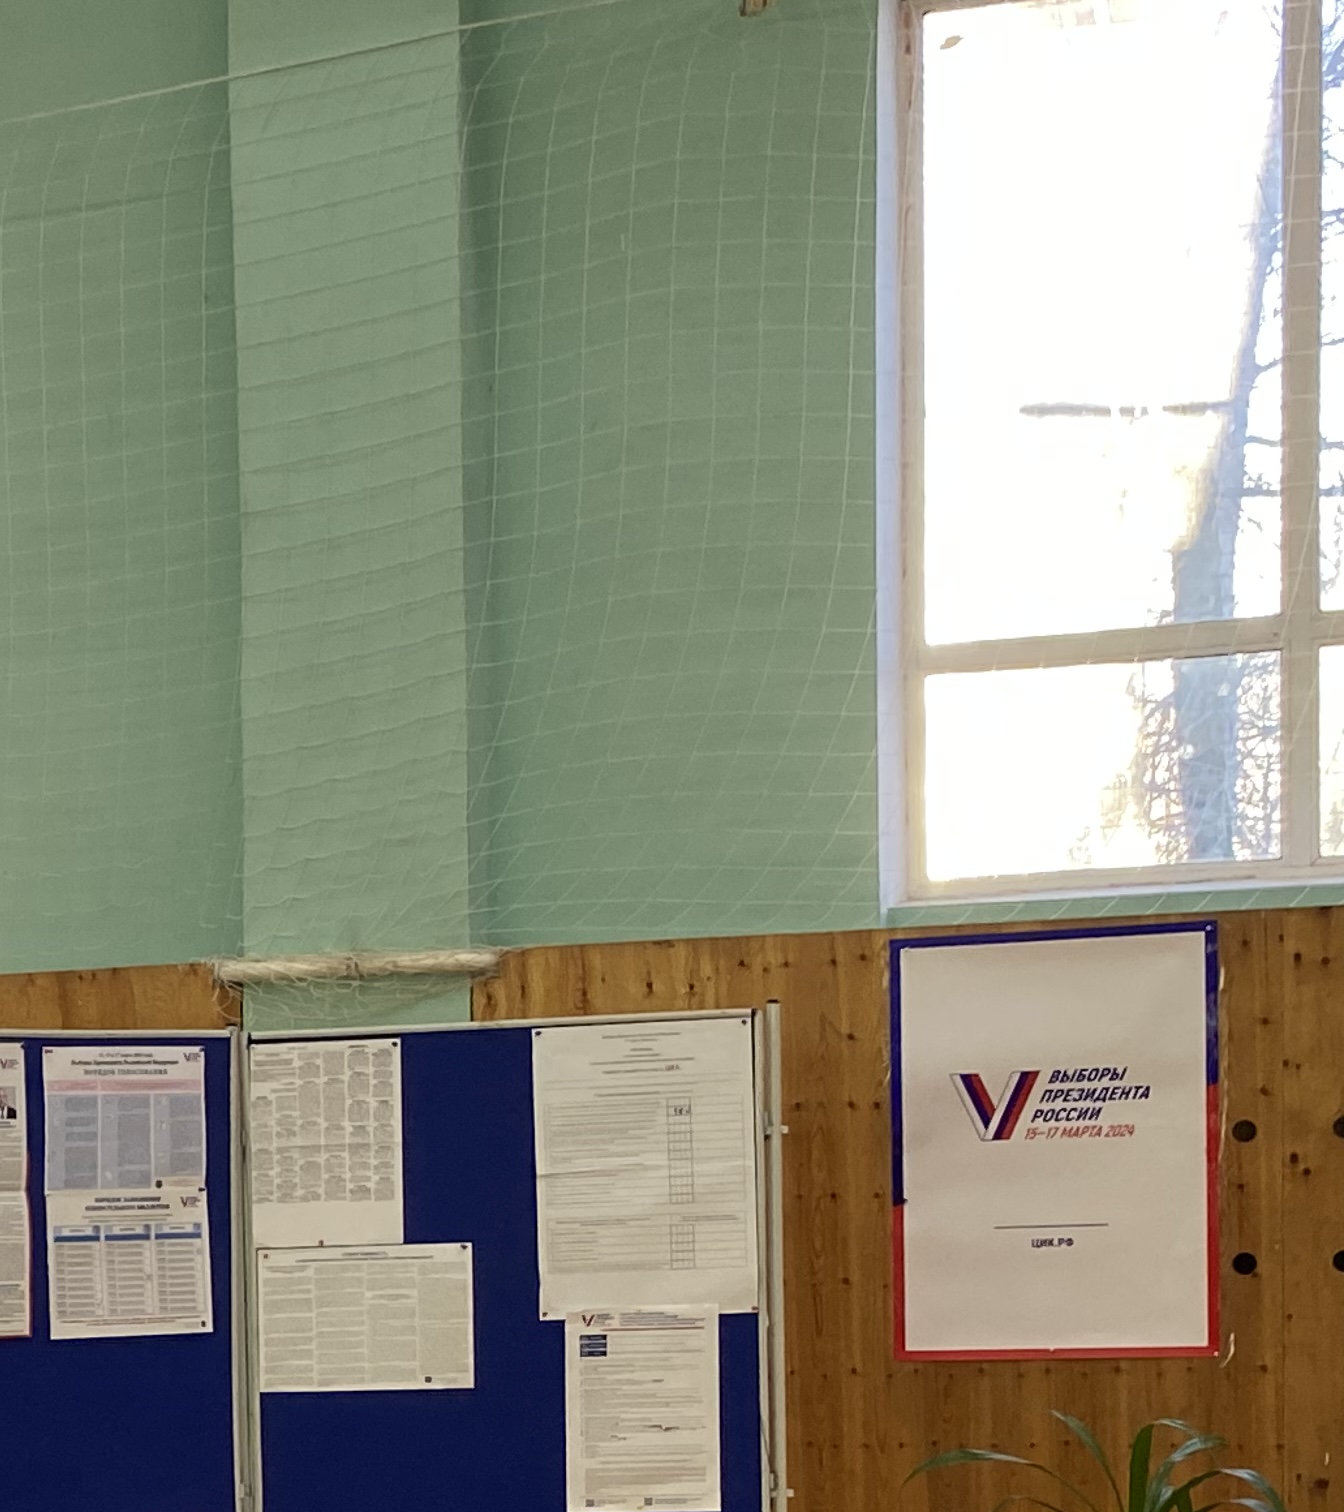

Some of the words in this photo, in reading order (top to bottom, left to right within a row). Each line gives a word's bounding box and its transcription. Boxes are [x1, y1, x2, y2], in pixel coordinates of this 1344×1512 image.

[1047, 1066, 1128, 1084] ВЫБОРЫ
[1039, 1085, 1151, 1104] ПРЕЗИДЕНТА
[1031, 1106, 1103, 1123] РОССИИ
[1060, 1125, 1103, 1139] МАРТА
[1104, 1124, 1135, 1138] 2024
